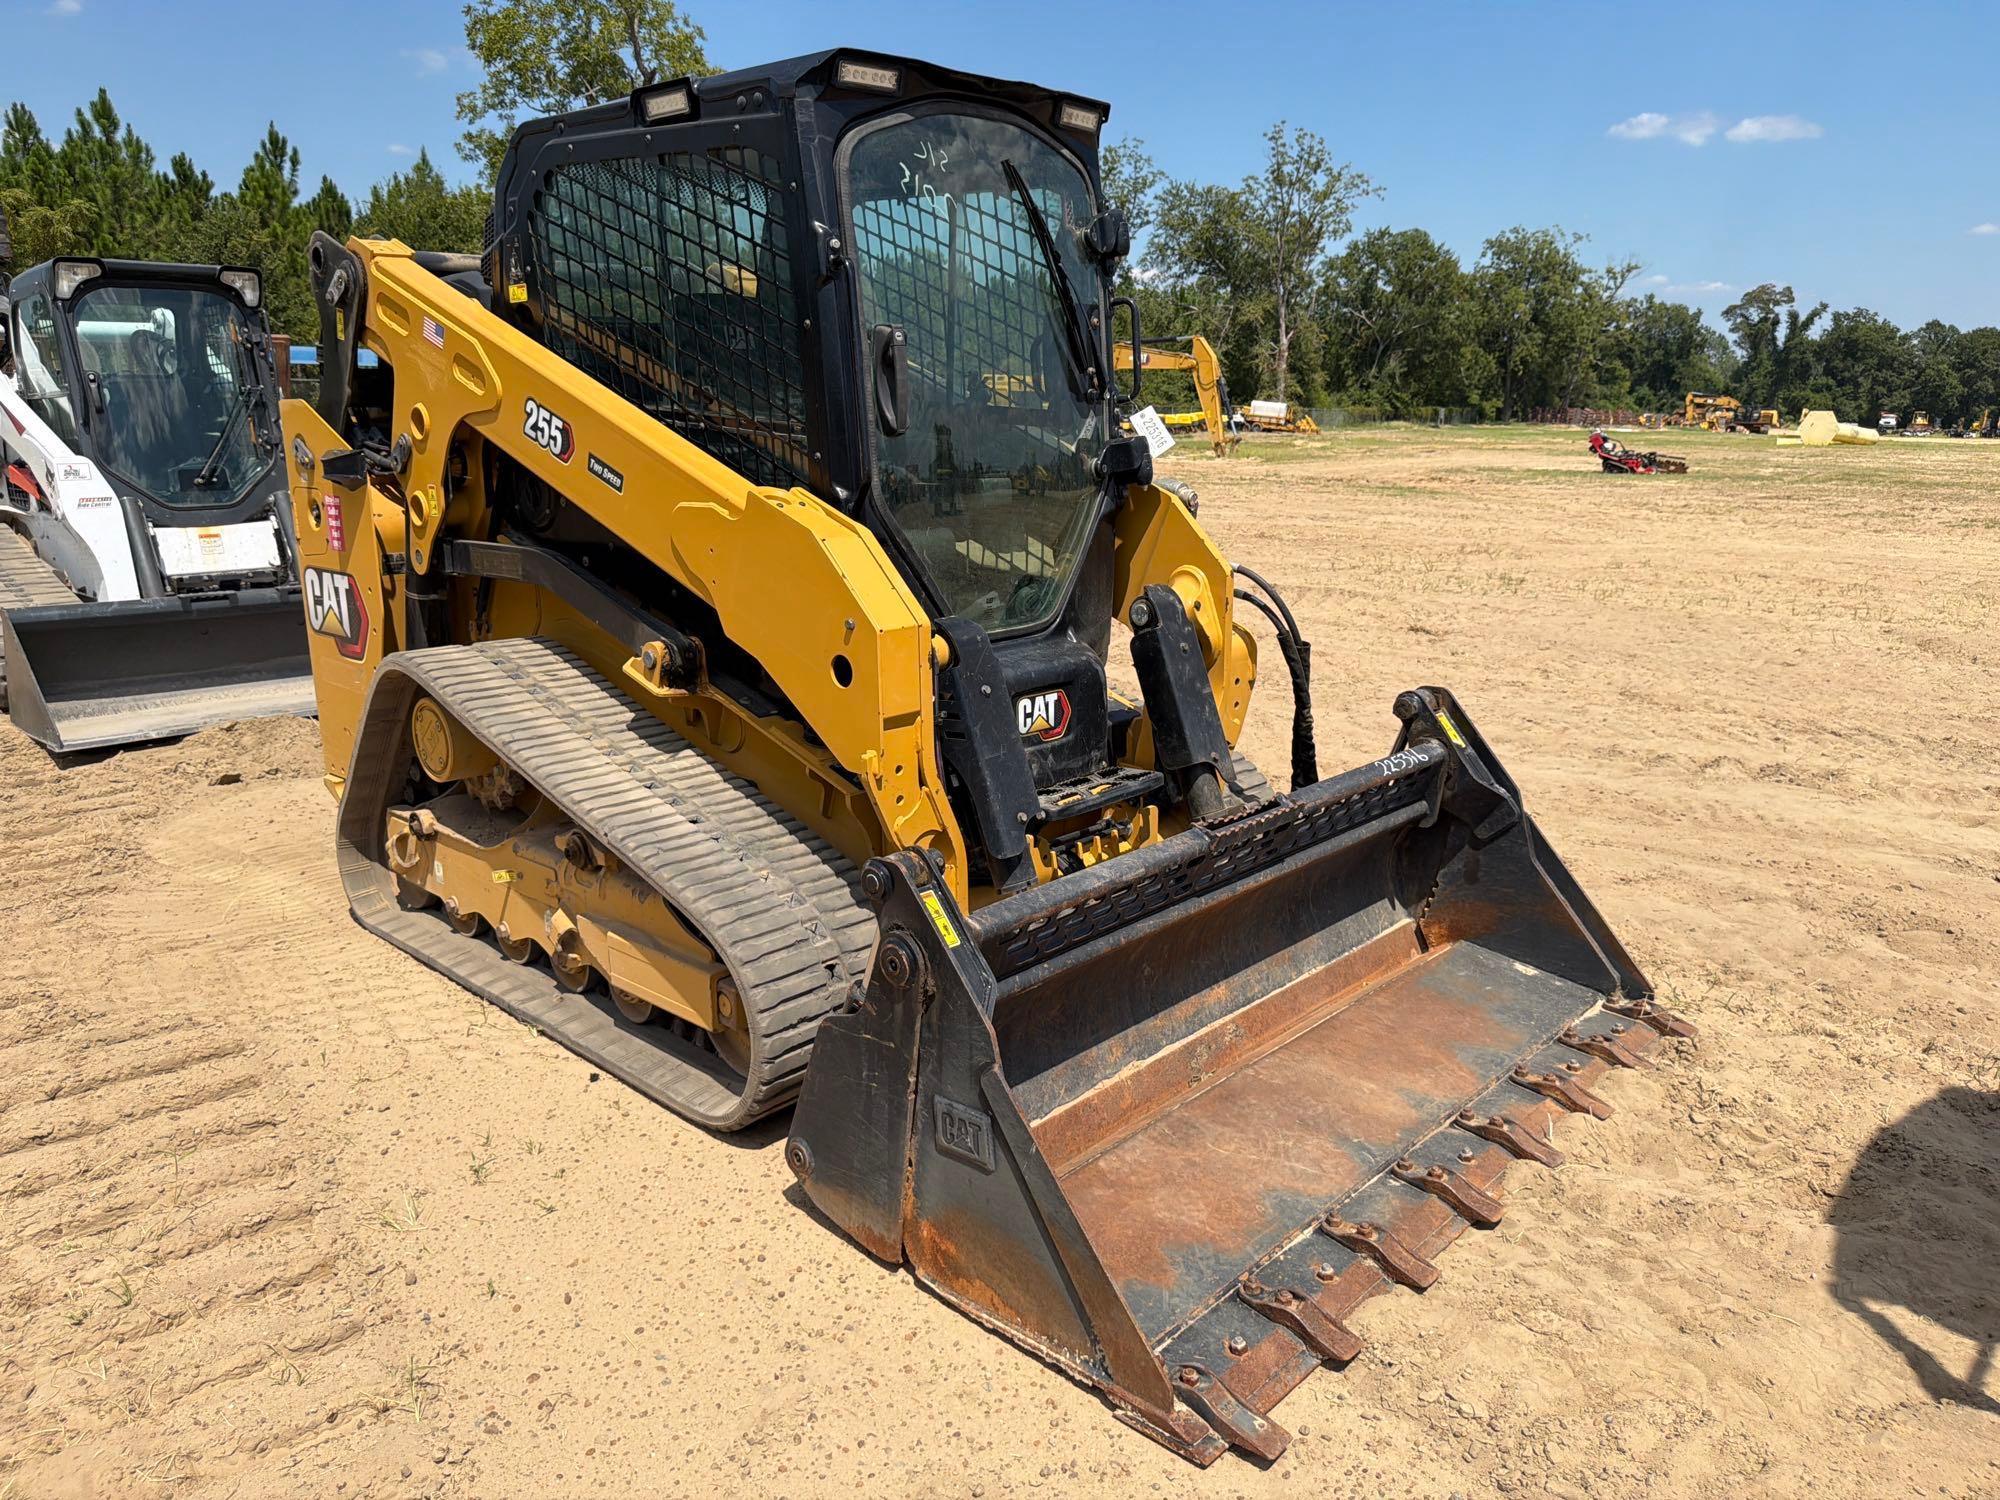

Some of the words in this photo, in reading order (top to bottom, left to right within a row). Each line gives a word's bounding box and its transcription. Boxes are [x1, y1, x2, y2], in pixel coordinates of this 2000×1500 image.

[523, 399, 564, 456] 255
[1143, 417, 1168, 449] 225316
[304, 567, 352, 639] CAT
[1018, 692, 1059, 734] CAT
[1374, 748, 1429, 777] 225316
[941, 1111, 982, 1159] CAT
